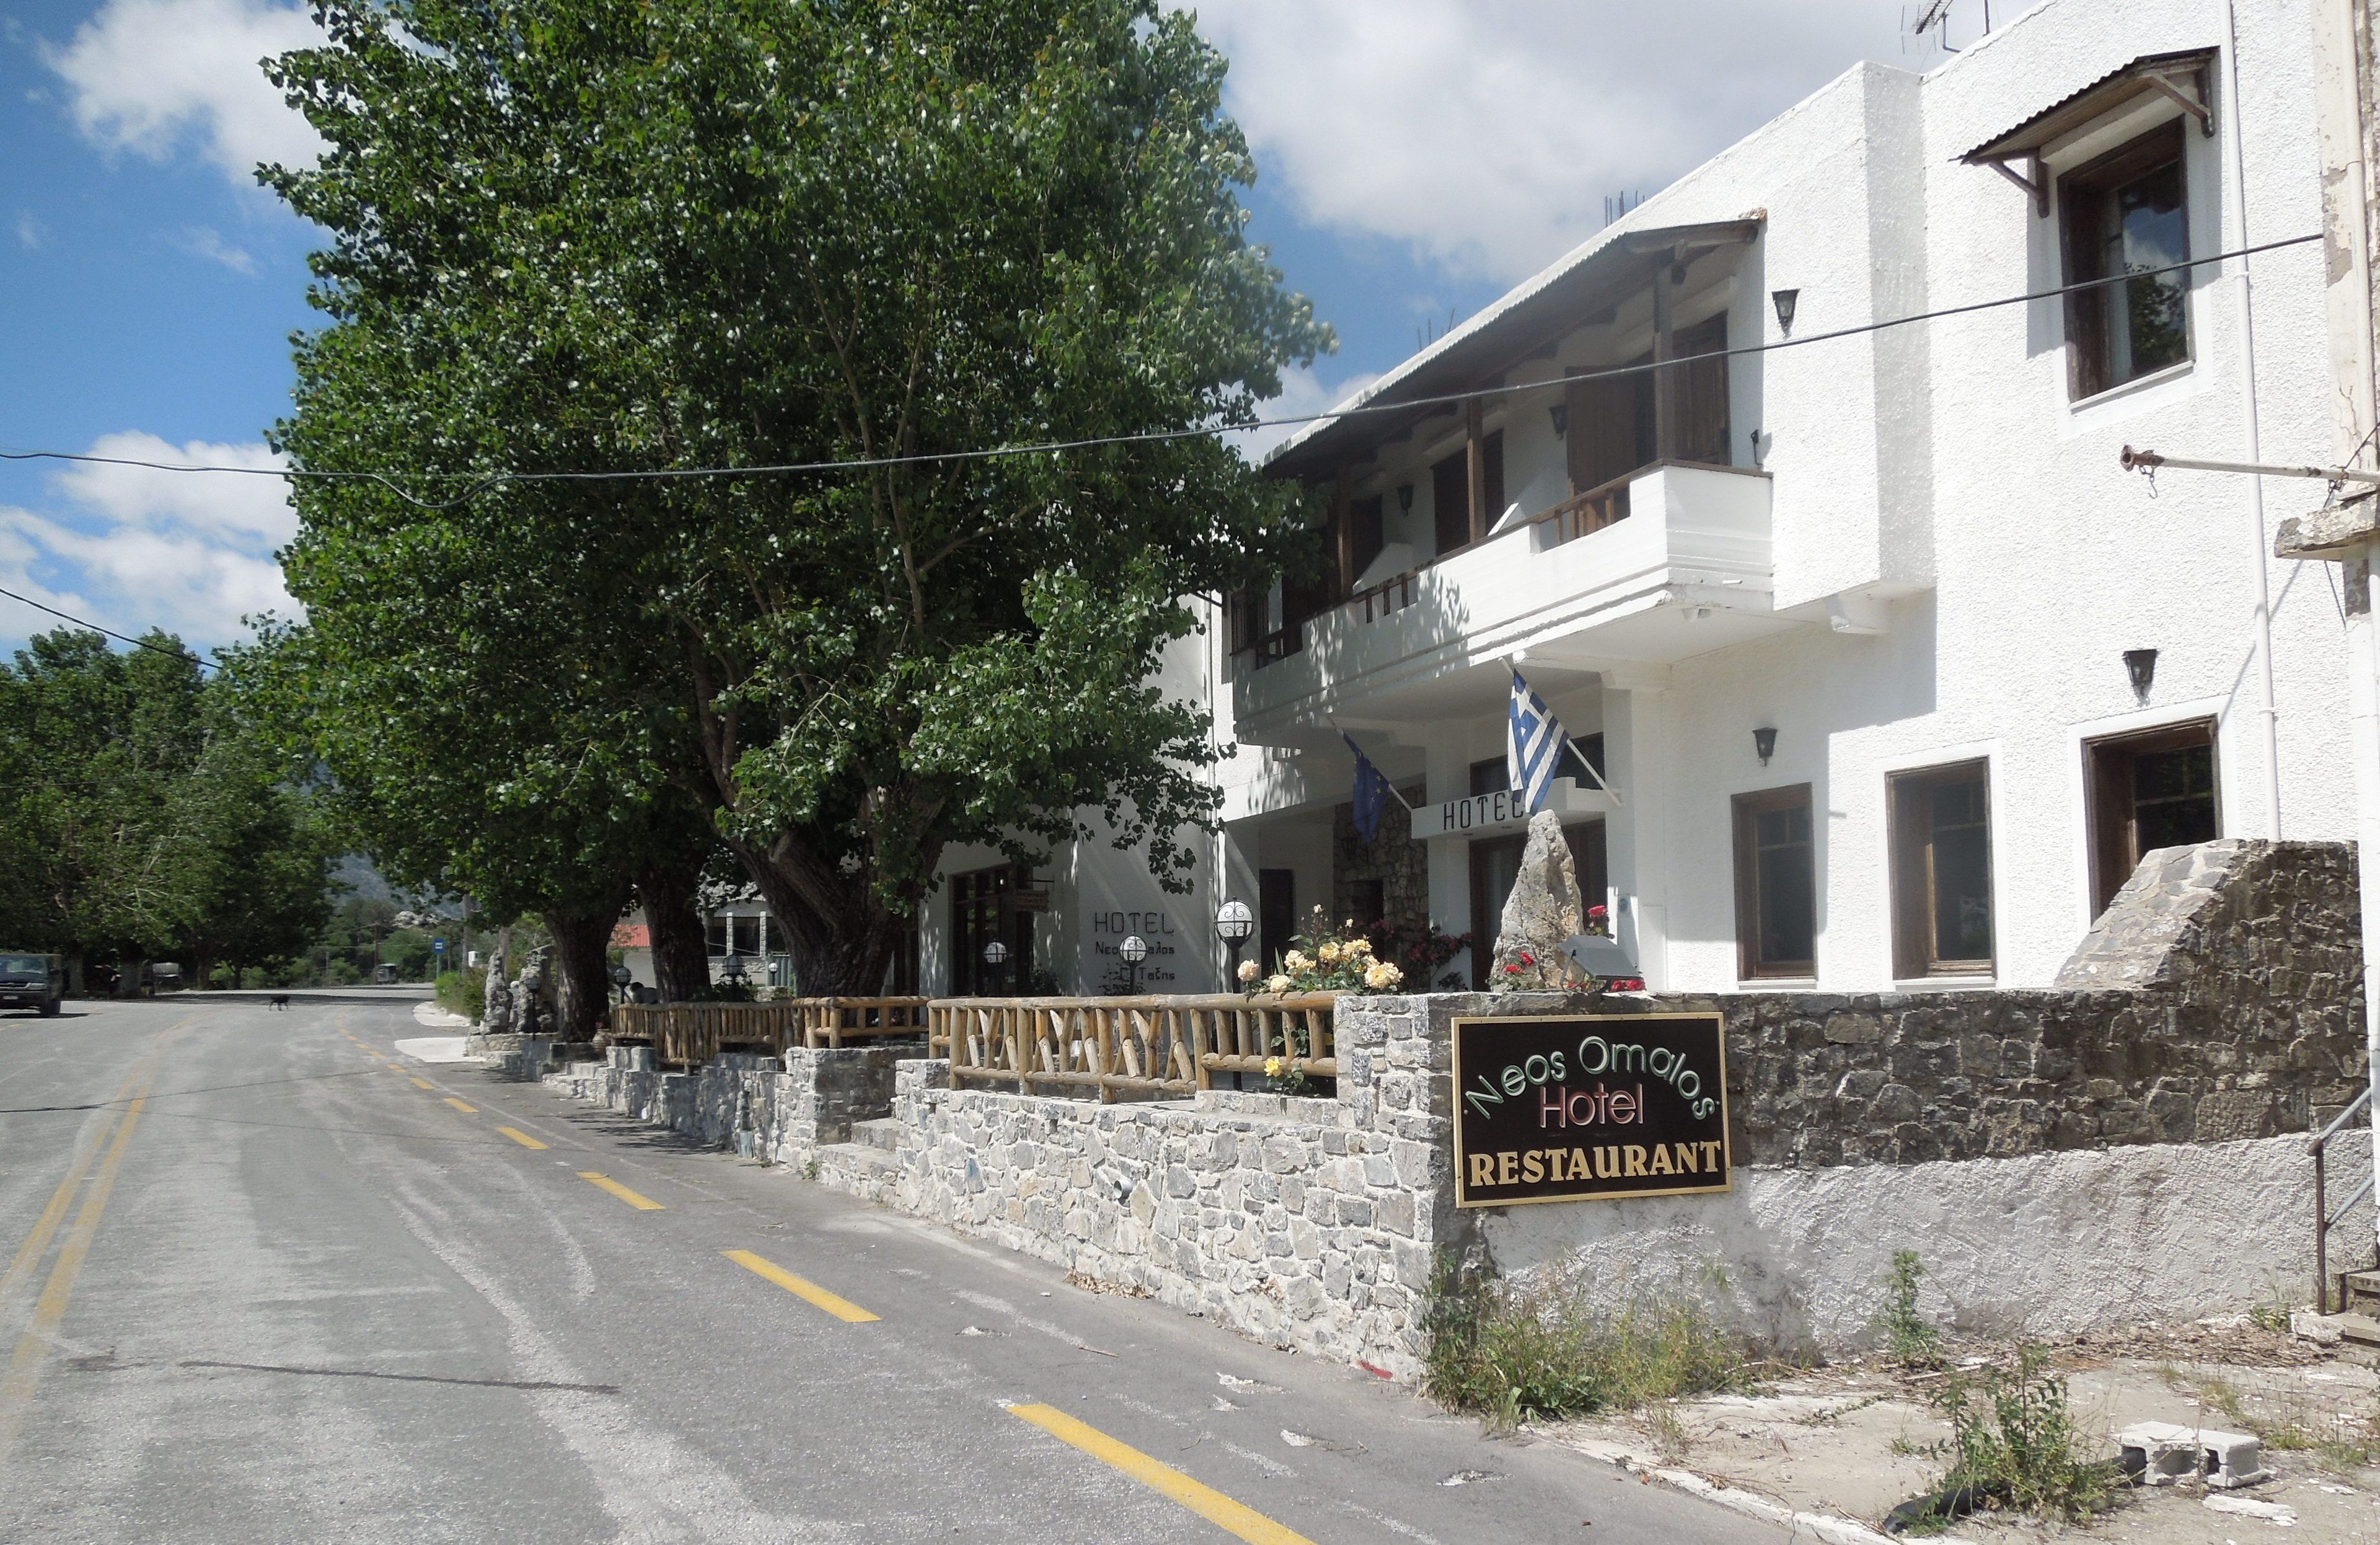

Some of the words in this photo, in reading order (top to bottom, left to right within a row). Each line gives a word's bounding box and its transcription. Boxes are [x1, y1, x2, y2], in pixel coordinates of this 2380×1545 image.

[1095, 912, 1175, 934] HOTEL
[1465, 1050, 1567, 1120] Neos
[1579, 1036, 1716, 1120] Omalos
[1540, 1082, 1643, 1128] Hotel
[1468, 1140, 1722, 1187] RESTAURANT
